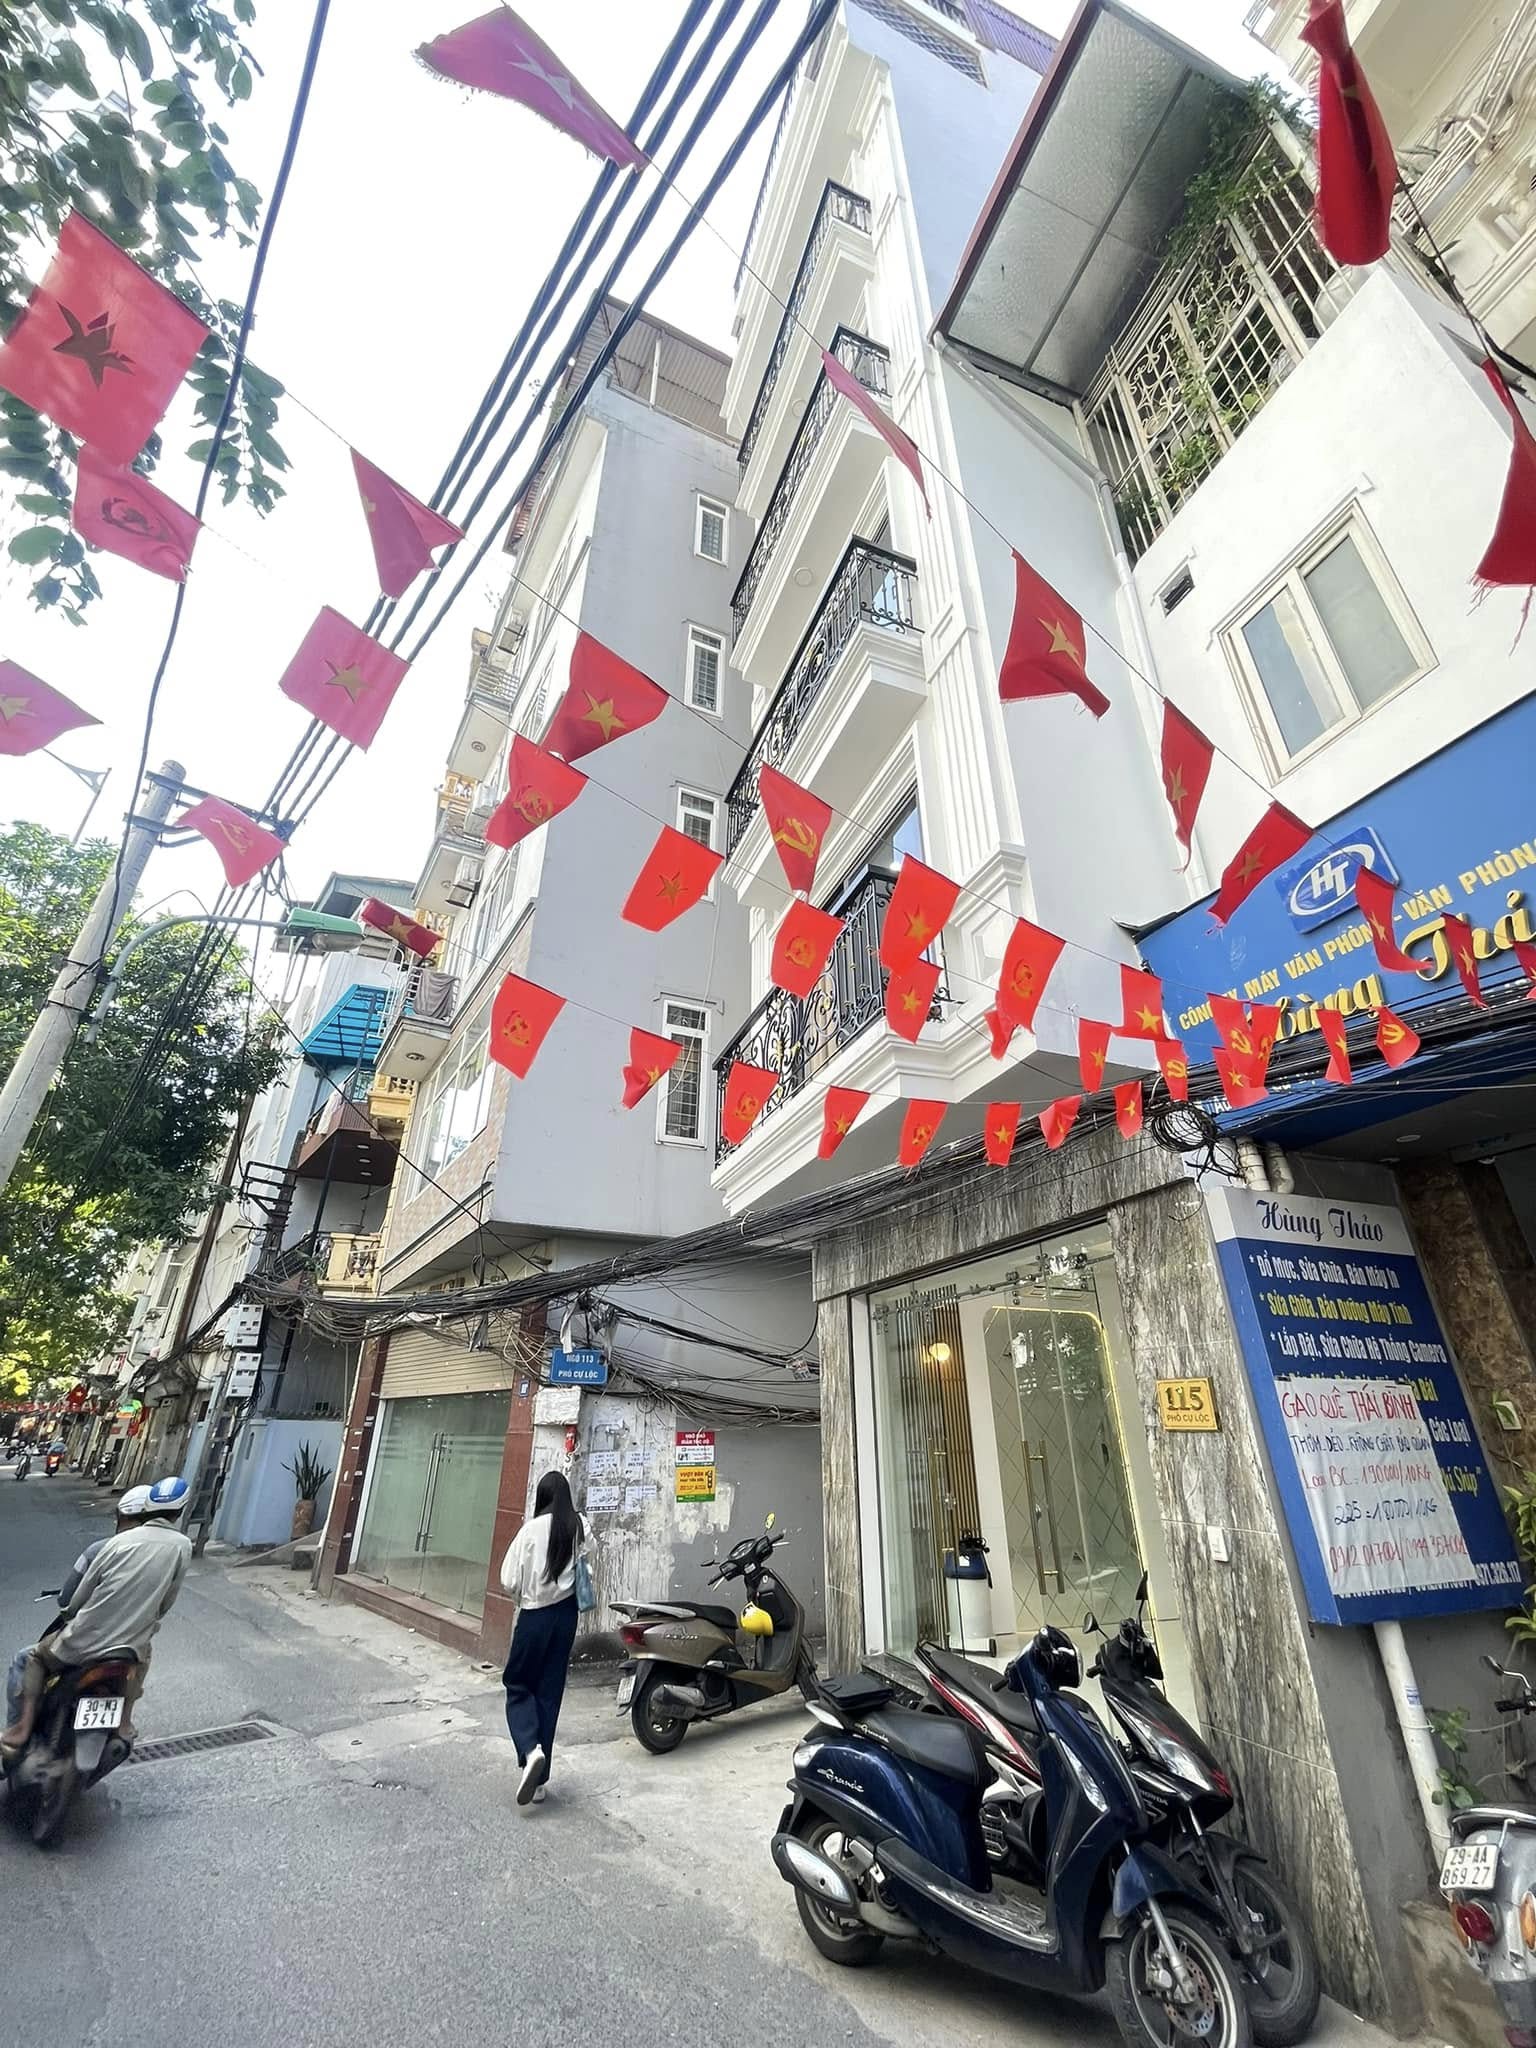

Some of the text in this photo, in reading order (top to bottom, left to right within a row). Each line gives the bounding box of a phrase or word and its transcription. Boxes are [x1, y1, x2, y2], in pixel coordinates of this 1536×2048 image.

[1311, 859, 1349, 899] HT
[1179, 1000, 1214, 1031] CÔN
[1243, 967, 1281, 1000] MÁY
[1283, 947, 1323, 980] VĂN
[1323, 922, 1373, 962] PHÒN
[1402, 884, 1453, 921] VĂN
[1458, 837, 1536, 895] PHÒN
[1256, 1199, 1384, 1242] Hùng Thảo
[1301, 1257, 1319, 1283] Sửa
[1347, 1263, 1368, 1286] Bán
[1367, 1265, 1389, 1290] Máy
[1267, 1289, 1288, 1316] Sửa
[1316, 1293, 1338, 1319] Bảo
[1368, 1300, 1391, 1325] Máy
[582, 1354, 594, 1364] 113
[1319, 1330, 1341, 1357] Sửa
[1340, 1334, 1364, 1360] Chữa
[1379, 1333, 1411, 1363] Thống
[1408, 1340, 1448, 1364] Camera
[1165, 1386, 1204, 1411] 115
[1428, 1416, 1451, 1442] Các
[82, 1712, 115, 1727] 5741
